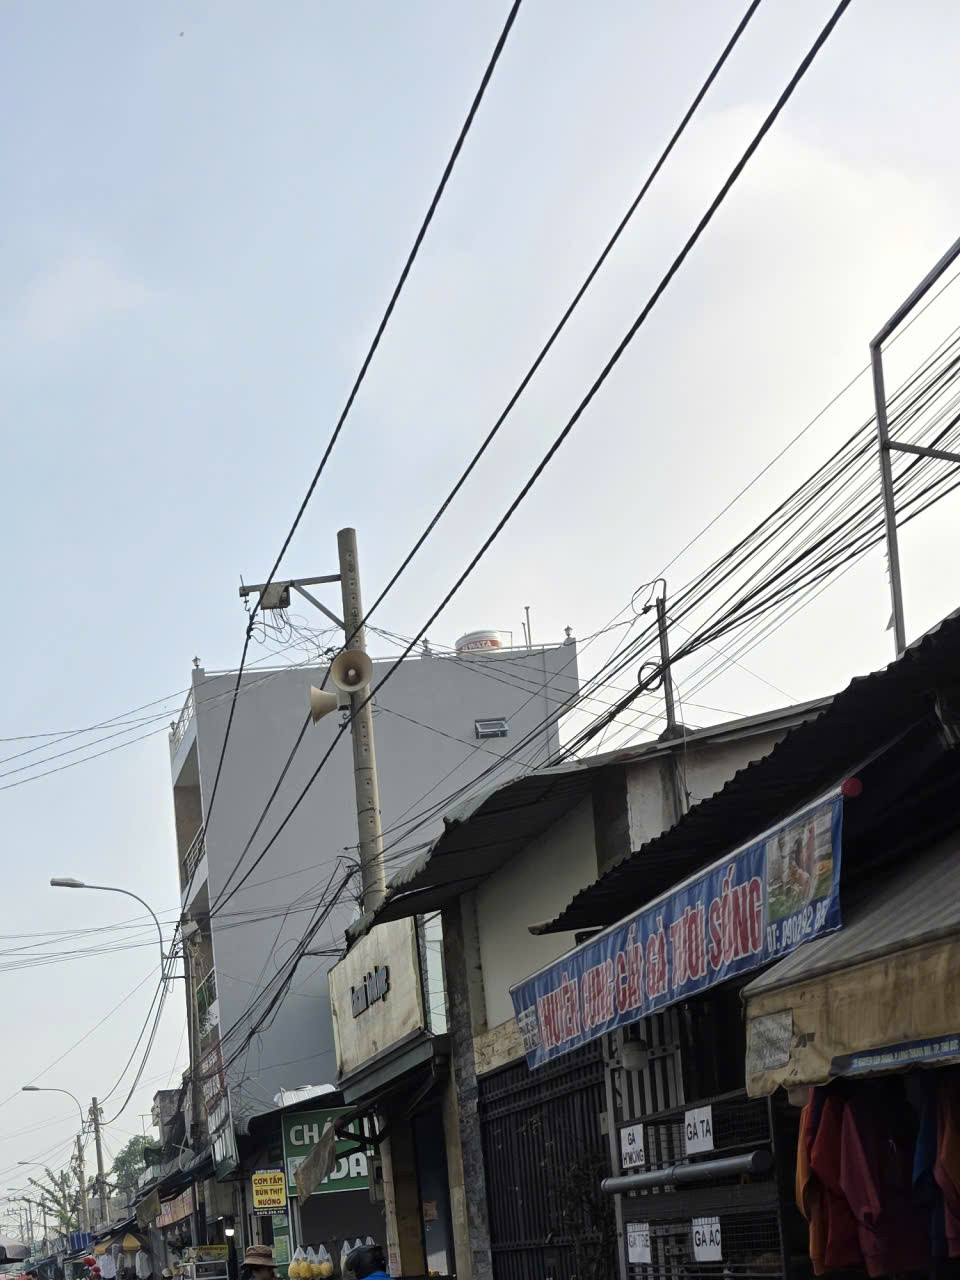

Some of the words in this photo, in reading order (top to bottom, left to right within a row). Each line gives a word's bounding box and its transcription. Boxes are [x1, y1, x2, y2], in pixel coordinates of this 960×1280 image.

[537, 971, 581, 1052] HUYÊN
[581, 957, 615, 1032] CUNG
[645, 915, 669, 1000] GÀ
[669, 900, 707, 989] TƯƠI
[709, 863, 764, 971] SỐNG
[627, 1127, 636, 1145] GÀ
[686, 1117, 699, 1141] GÀ
[699, 1119, 712, 1138] TA
[253, 1177, 268, 1185] CƠM
[269, 1175, 283, 1184] TẤM
[255, 1188, 268, 1196] BÚN
[694, 1224, 707, 1248] GÀ
[709, 1223, 721, 1247] ÁC
